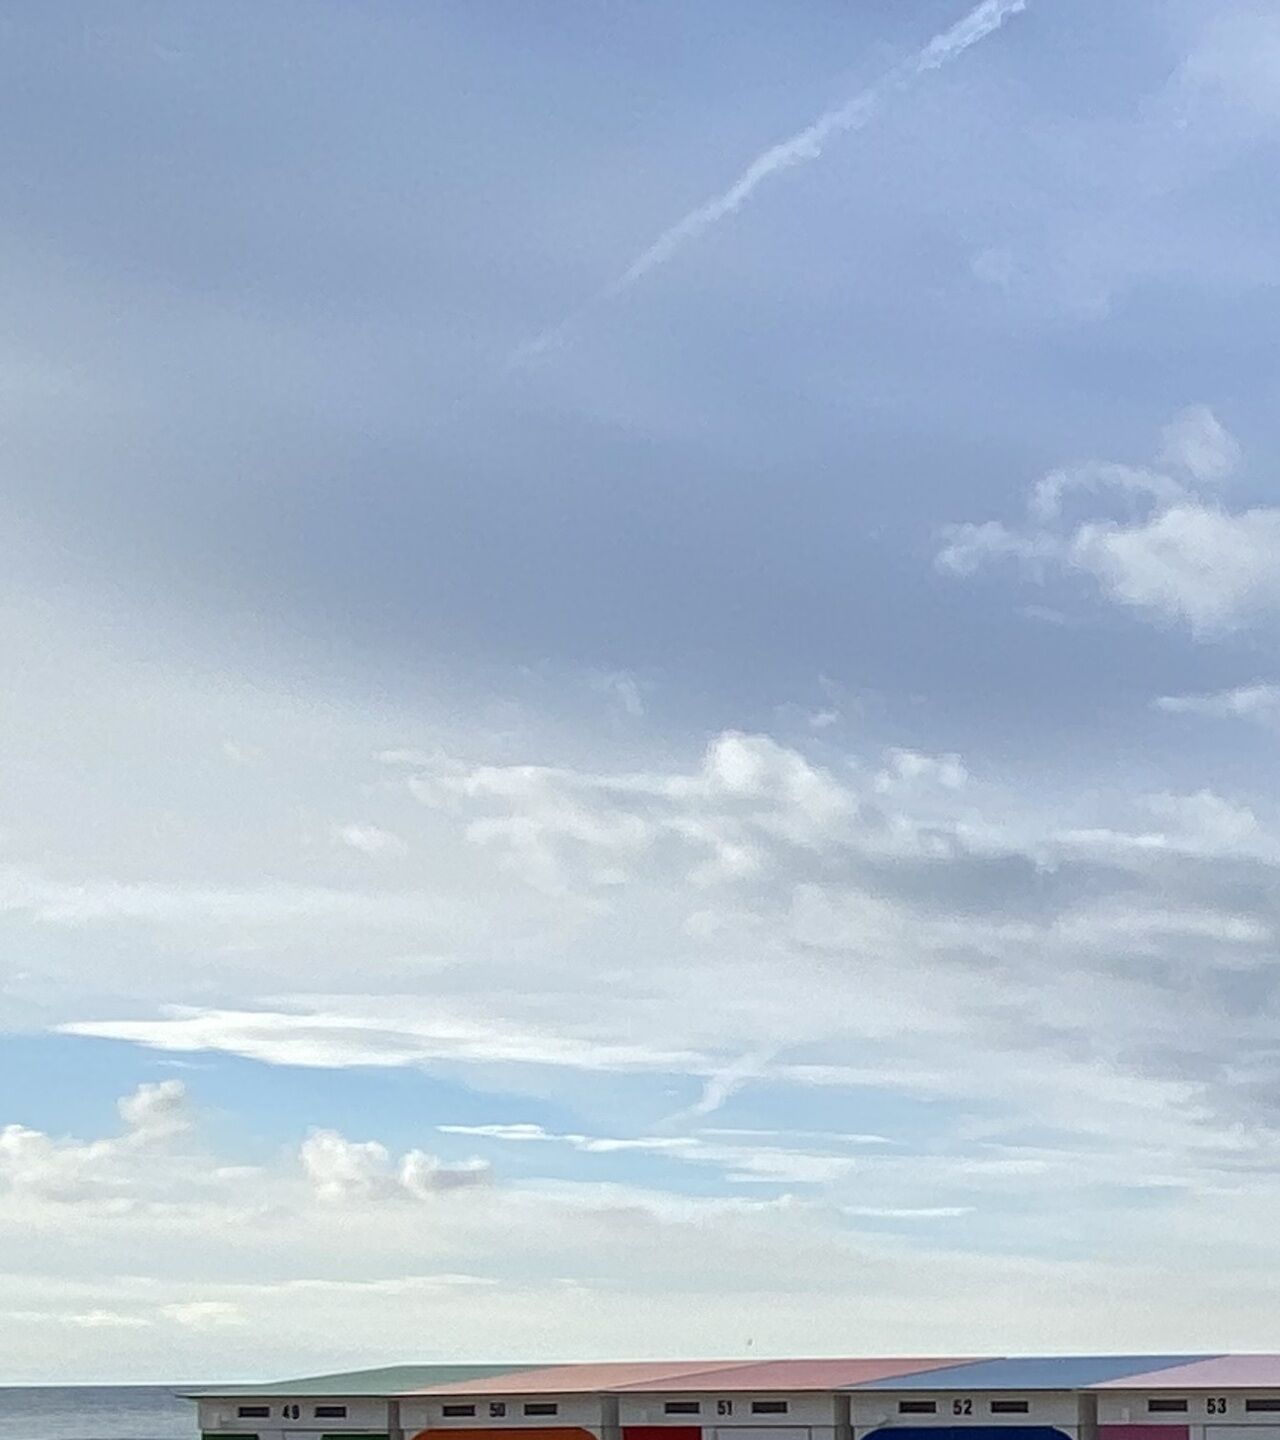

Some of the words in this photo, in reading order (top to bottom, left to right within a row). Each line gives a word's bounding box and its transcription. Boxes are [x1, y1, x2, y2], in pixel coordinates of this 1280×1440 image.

[489, 1402, 507, 1418] 50
[717, 1400, 733, 1416] 51
[954, 1398, 973, 1415] 52
[1207, 1397, 1227, 1415] 53
